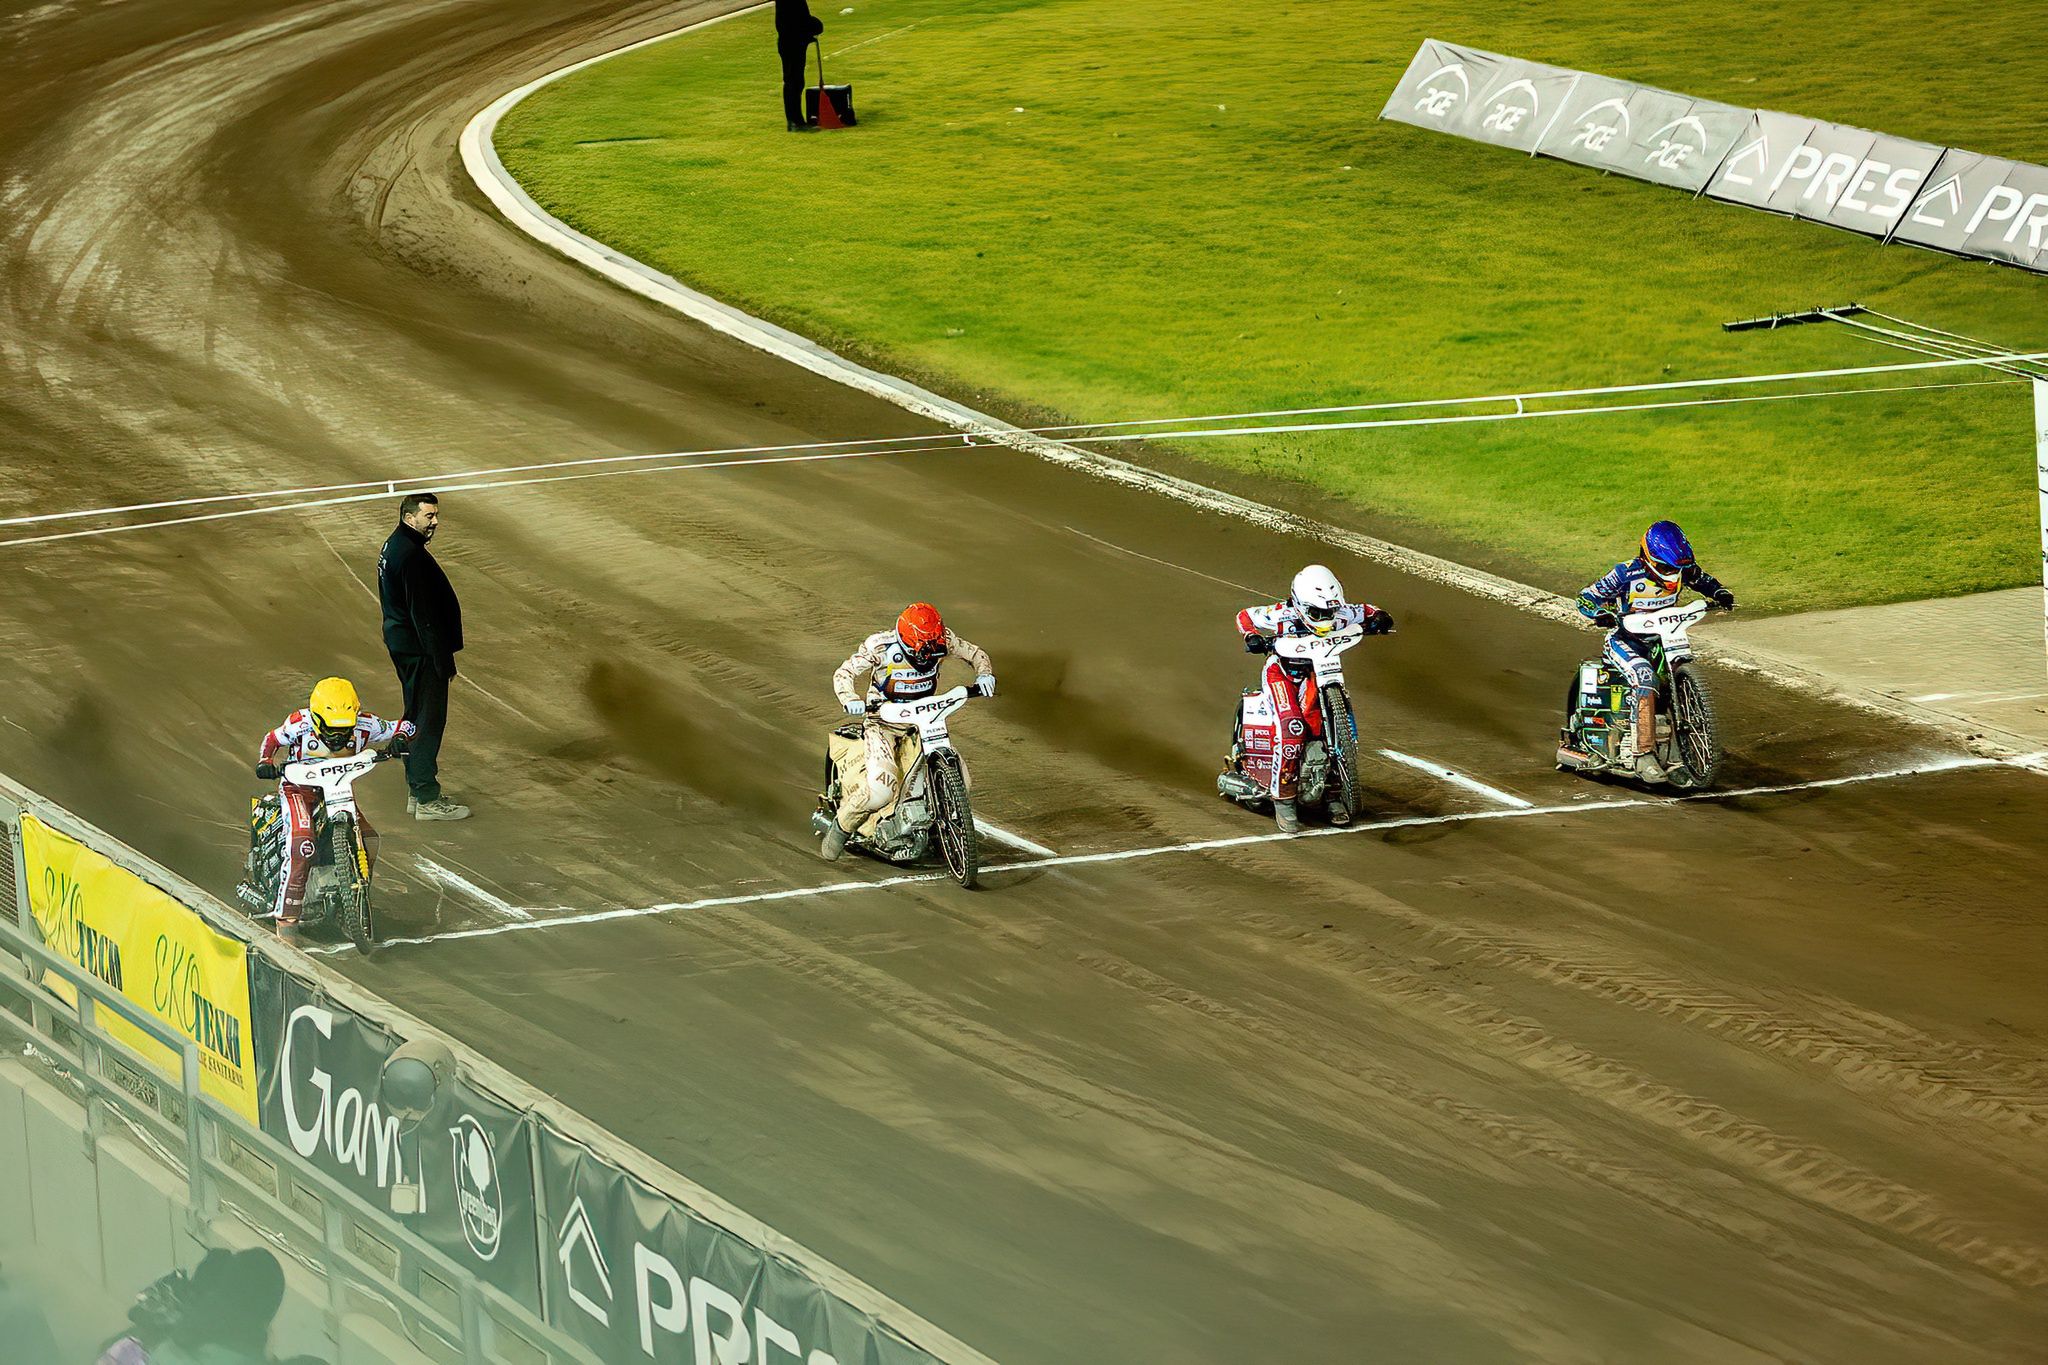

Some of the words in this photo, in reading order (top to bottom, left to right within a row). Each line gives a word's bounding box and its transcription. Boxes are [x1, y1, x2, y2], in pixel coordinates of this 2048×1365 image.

[1414, 87, 1458, 117] PGE
[1482, 103, 1527, 132] PGE
[1571, 122, 1618, 152] PGE
[1644, 139, 1693, 170] PGE
[1768, 143, 1921, 218] PRES
[1964, 185, 2048, 251] PR
[1658, 612, 1697, 626] PRES
[1310, 635, 1352, 650] PRES
[915, 697, 954, 715] PRES
[320, 761, 366, 777] PRES
